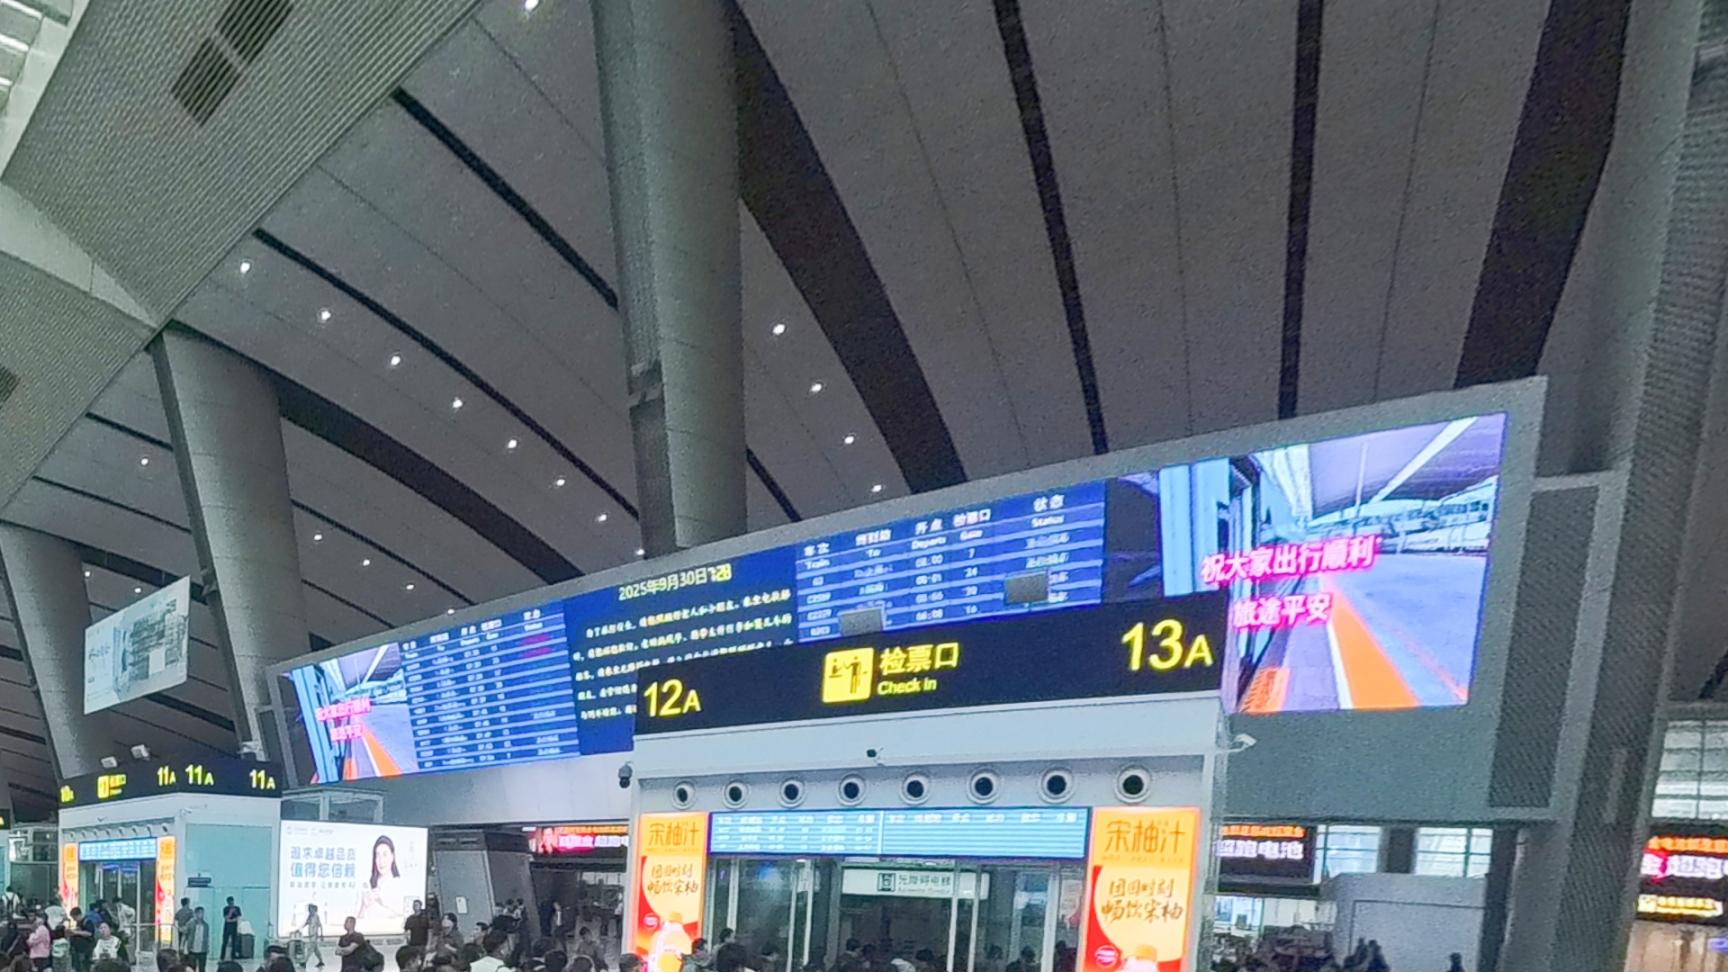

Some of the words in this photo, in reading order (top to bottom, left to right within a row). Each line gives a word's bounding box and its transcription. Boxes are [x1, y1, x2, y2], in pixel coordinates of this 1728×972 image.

[879, 642, 960, 676] 检票口
[1120, 618, 1215, 673] 13A
[643, 678, 702, 718] 12A
[877, 678, 922, 695] Check
[185, 764, 215, 786] 11A
[249, 768, 276, 790] 11A
